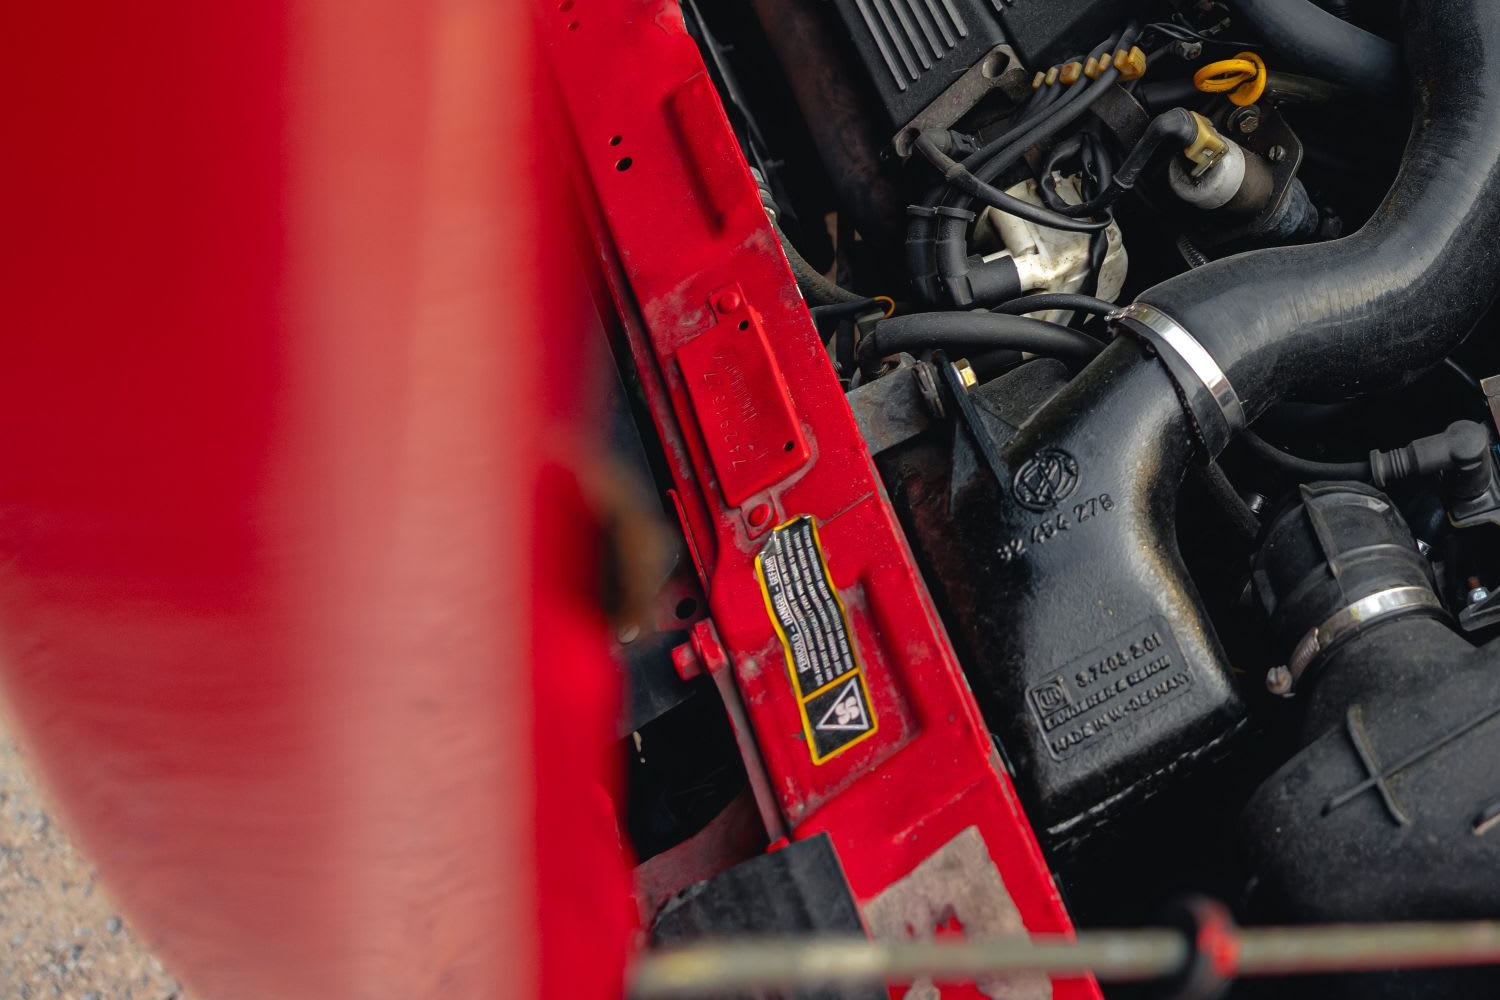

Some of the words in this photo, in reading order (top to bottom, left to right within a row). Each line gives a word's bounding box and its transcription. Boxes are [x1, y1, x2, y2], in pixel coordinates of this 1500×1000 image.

[764, 556, 779, 586] GEFAHR
[773, 592, 793, 626] DANGER
[790, 633, 809, 673] PERICOLO
[1051, 725, 1092, 753] MADE
[1091, 714, 1106, 730] IN
